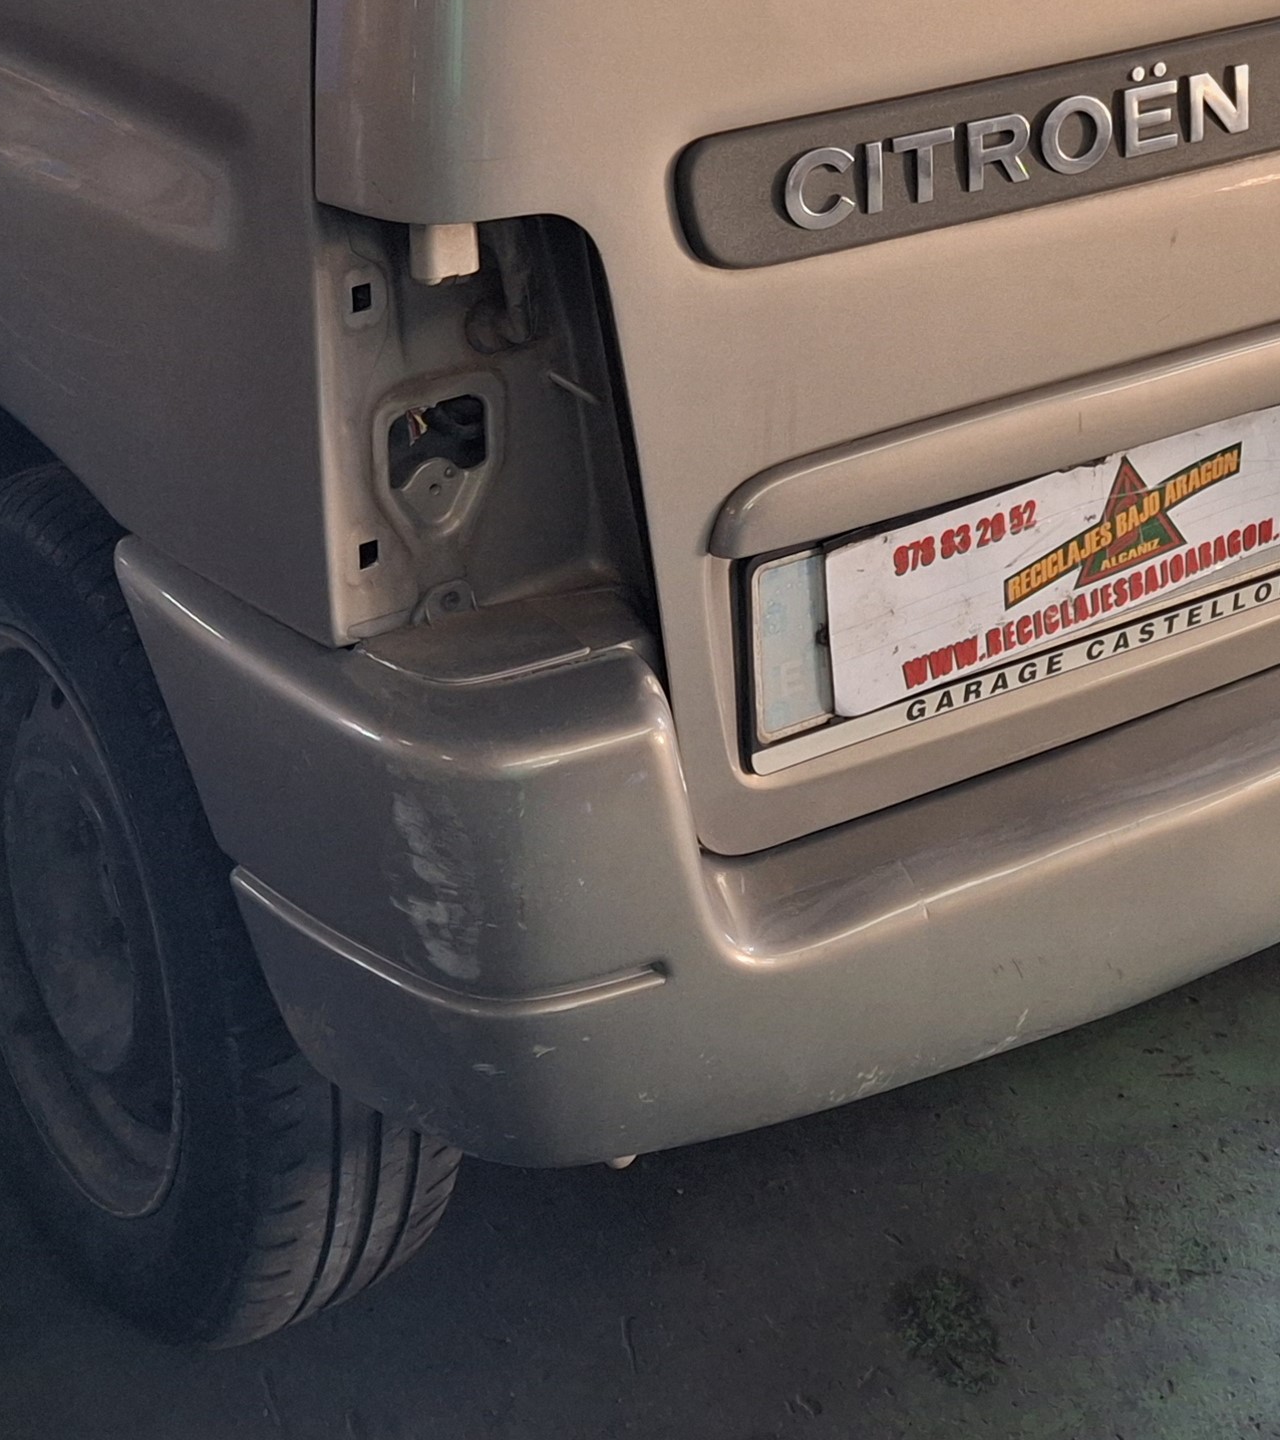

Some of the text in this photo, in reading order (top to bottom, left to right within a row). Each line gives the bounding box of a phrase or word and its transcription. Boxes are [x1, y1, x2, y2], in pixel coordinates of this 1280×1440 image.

[784, 61, 1250, 231] CITROËN
[893, 499, 1037, 577] 978 83 20 52
[1007, 521, 1113, 604] RECICLAJES
[1115, 490, 1161, 539] BAJO
[1100, 537, 1161, 572] ALCAÑIZ
[906, 652, 1064, 721] GARAGE
